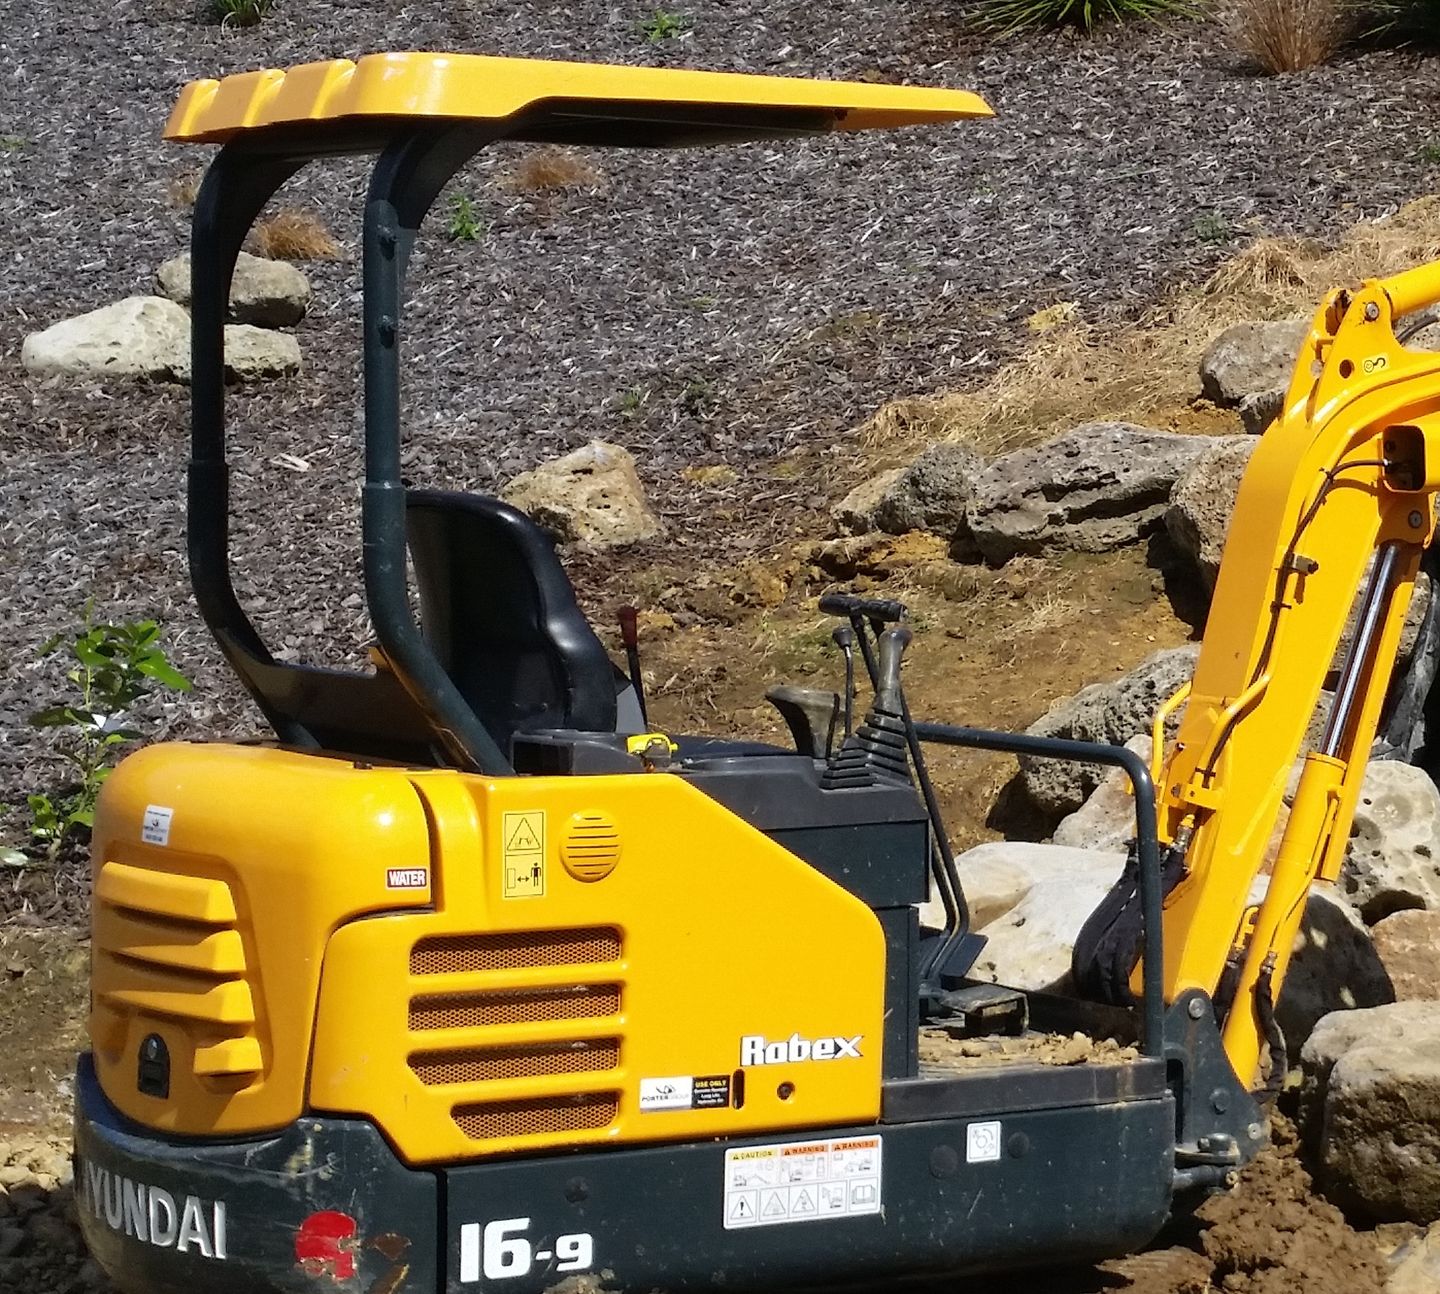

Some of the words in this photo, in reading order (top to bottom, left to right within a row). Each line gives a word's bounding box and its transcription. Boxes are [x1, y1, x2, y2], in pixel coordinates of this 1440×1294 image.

[388, 870, 426, 886] WATER
[740, 1032, 864, 1067] Robex
[792, 1145, 824, 1155] WARNING
[841, 1141, 874, 1150] WARNING
[741, 1151, 773, 1160] CAUTION
[460, 1217, 593, 1283] 16-9
